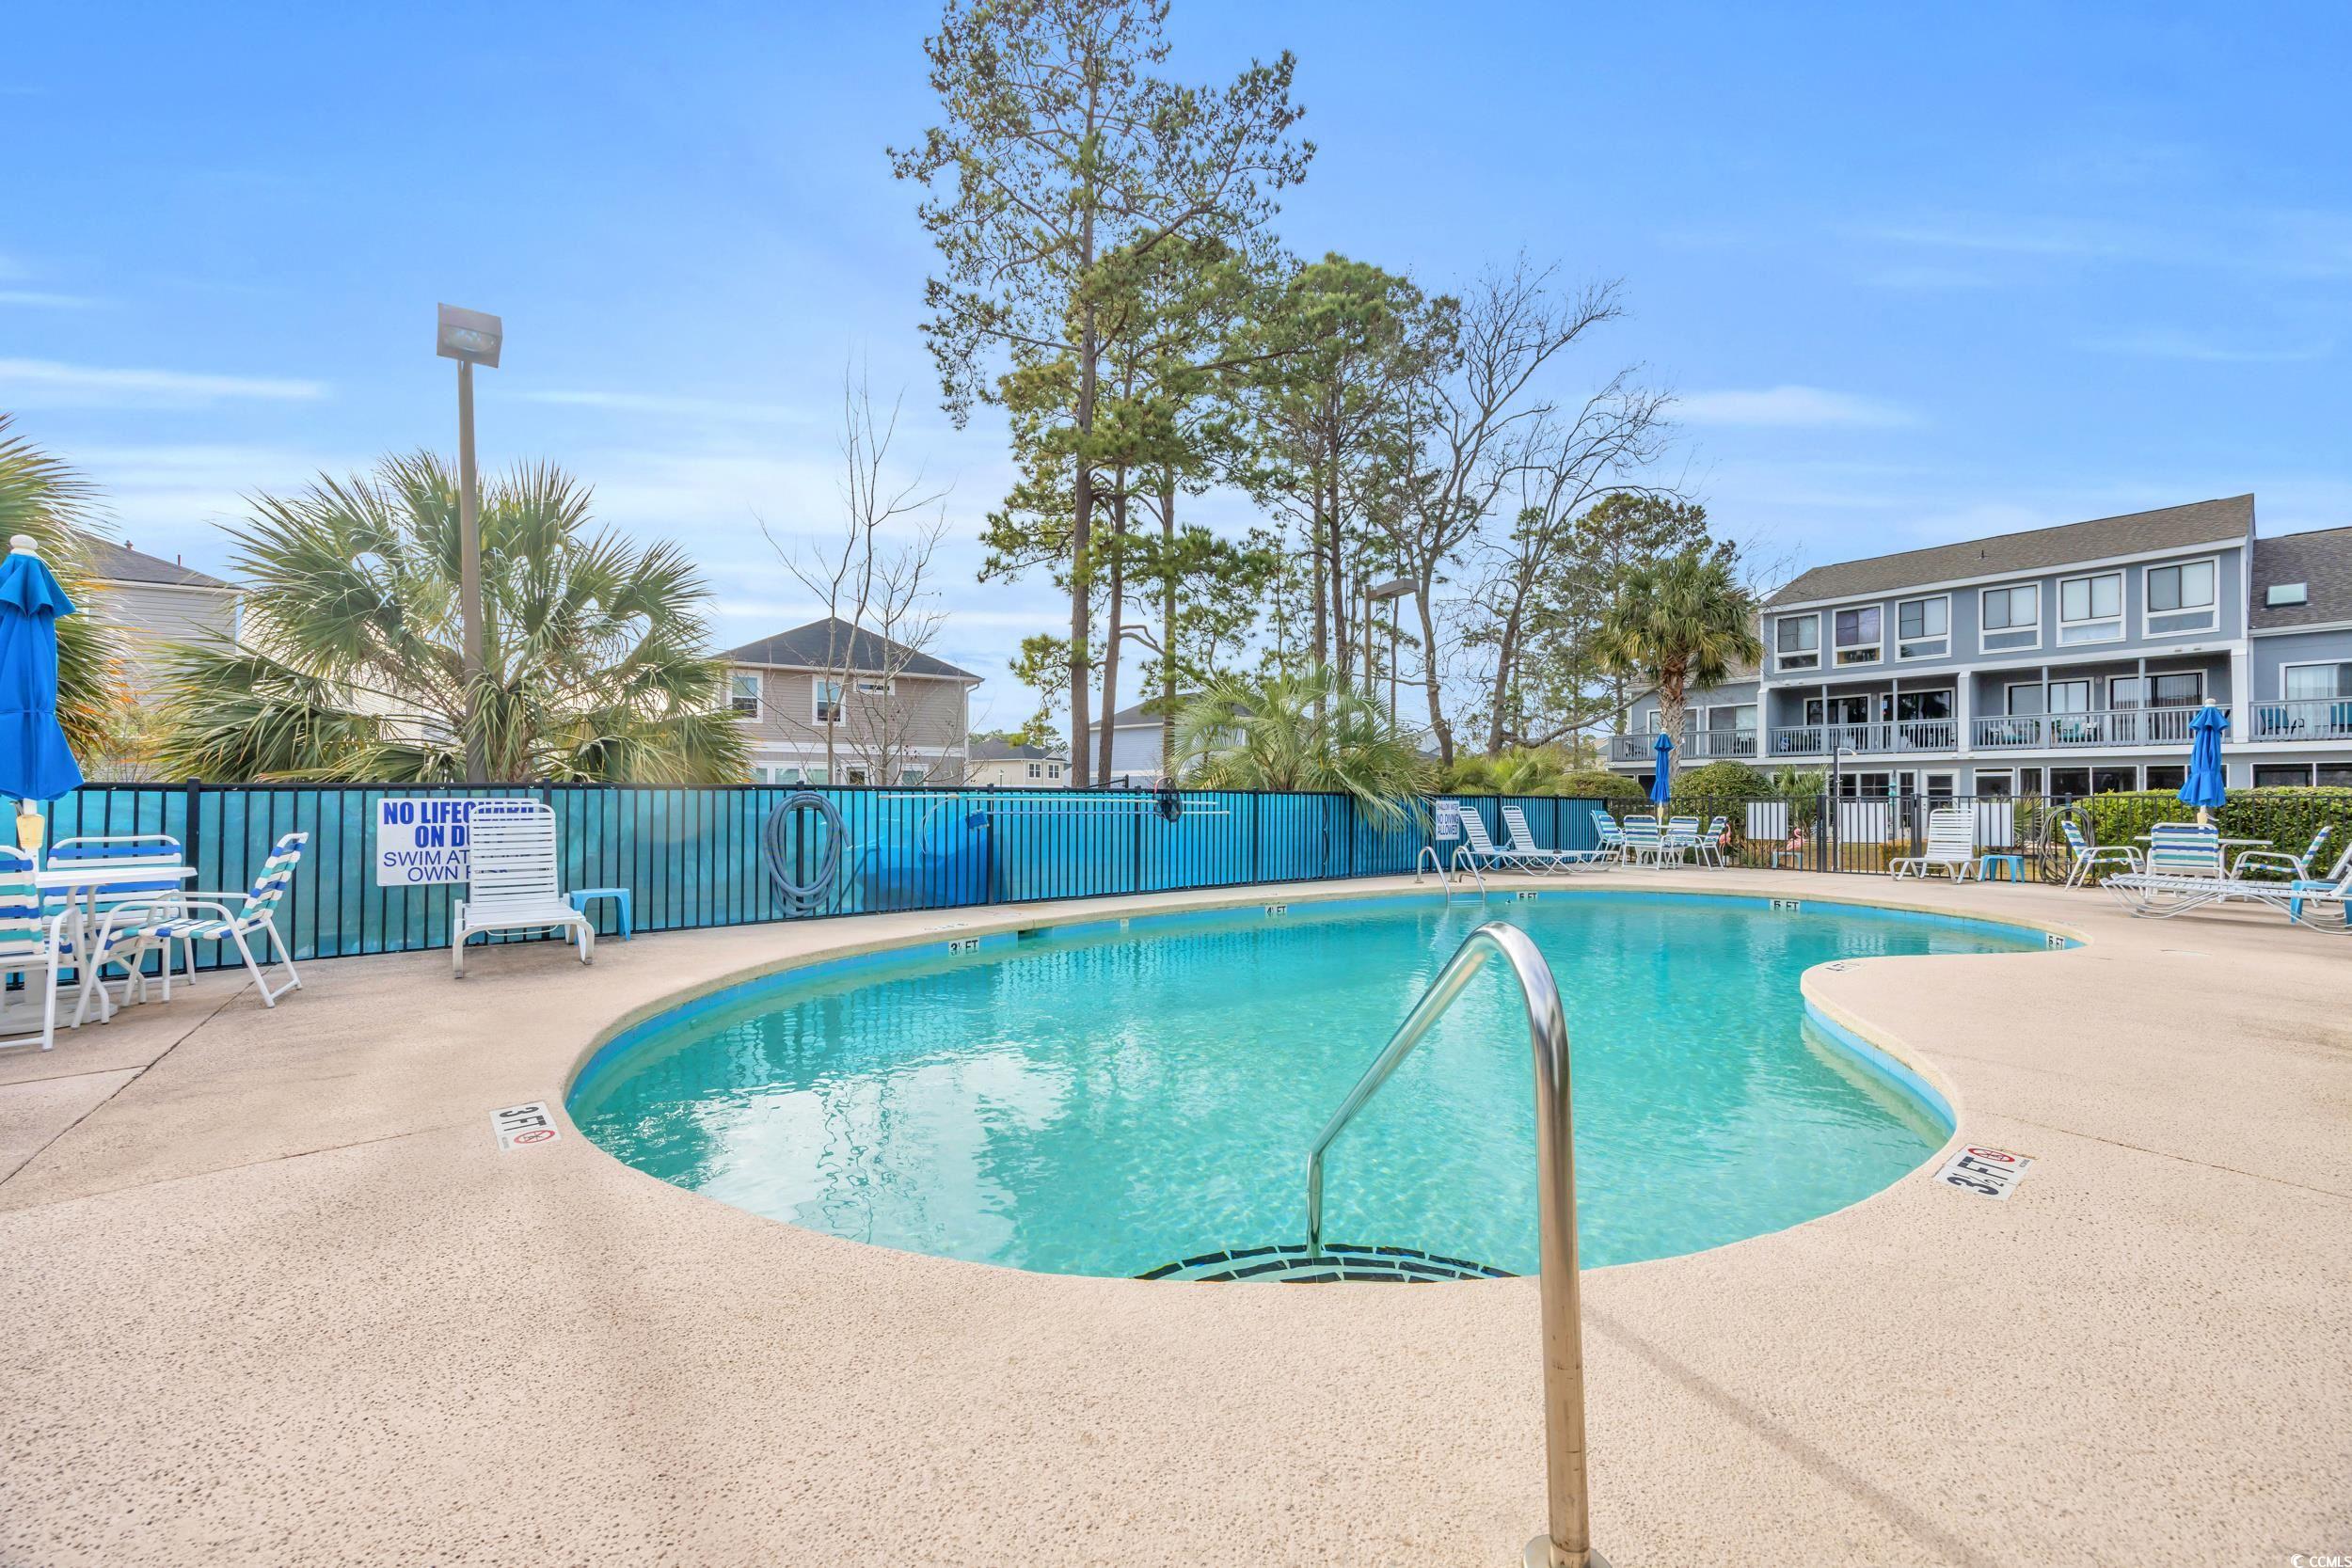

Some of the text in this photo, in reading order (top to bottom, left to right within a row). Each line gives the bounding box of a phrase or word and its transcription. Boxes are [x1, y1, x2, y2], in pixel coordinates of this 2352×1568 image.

[384, 801, 414, 825] NO
[415, 825, 445, 847] ON
[383, 850, 441, 867] SWIM
[447, 849, 470, 864] AT
[407, 865, 458, 881] OWN
